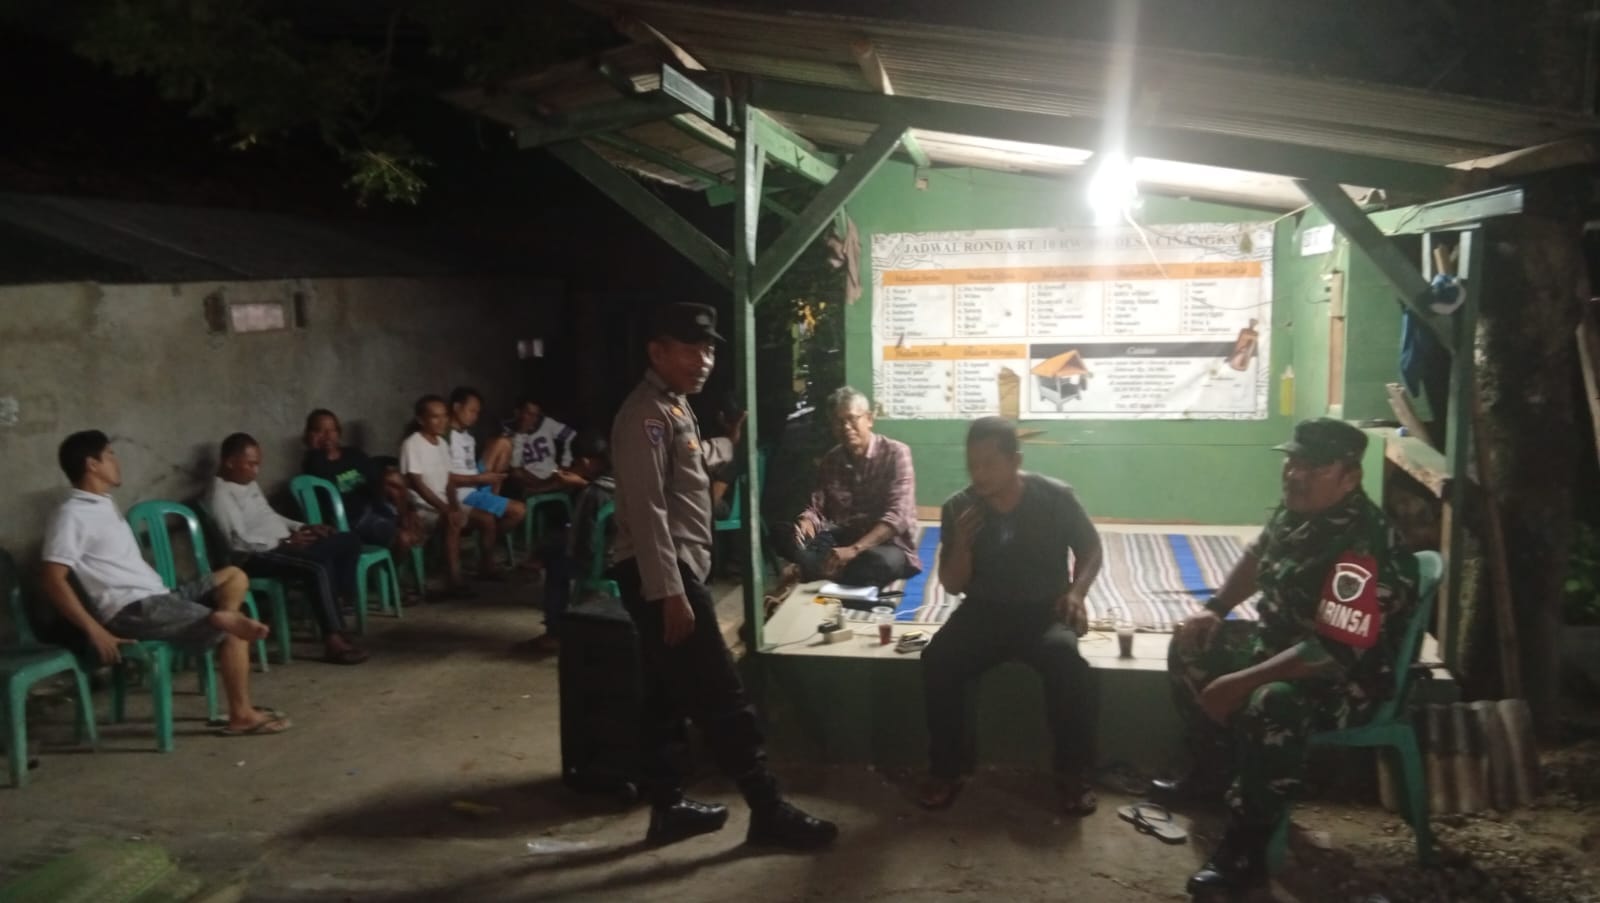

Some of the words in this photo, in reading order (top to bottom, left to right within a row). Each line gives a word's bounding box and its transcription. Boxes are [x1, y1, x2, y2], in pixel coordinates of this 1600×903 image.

[904, 241, 960, 255] JADWAL
[963, 239, 1013, 252] RONDA
[1015, 238, 1036, 251] RT
